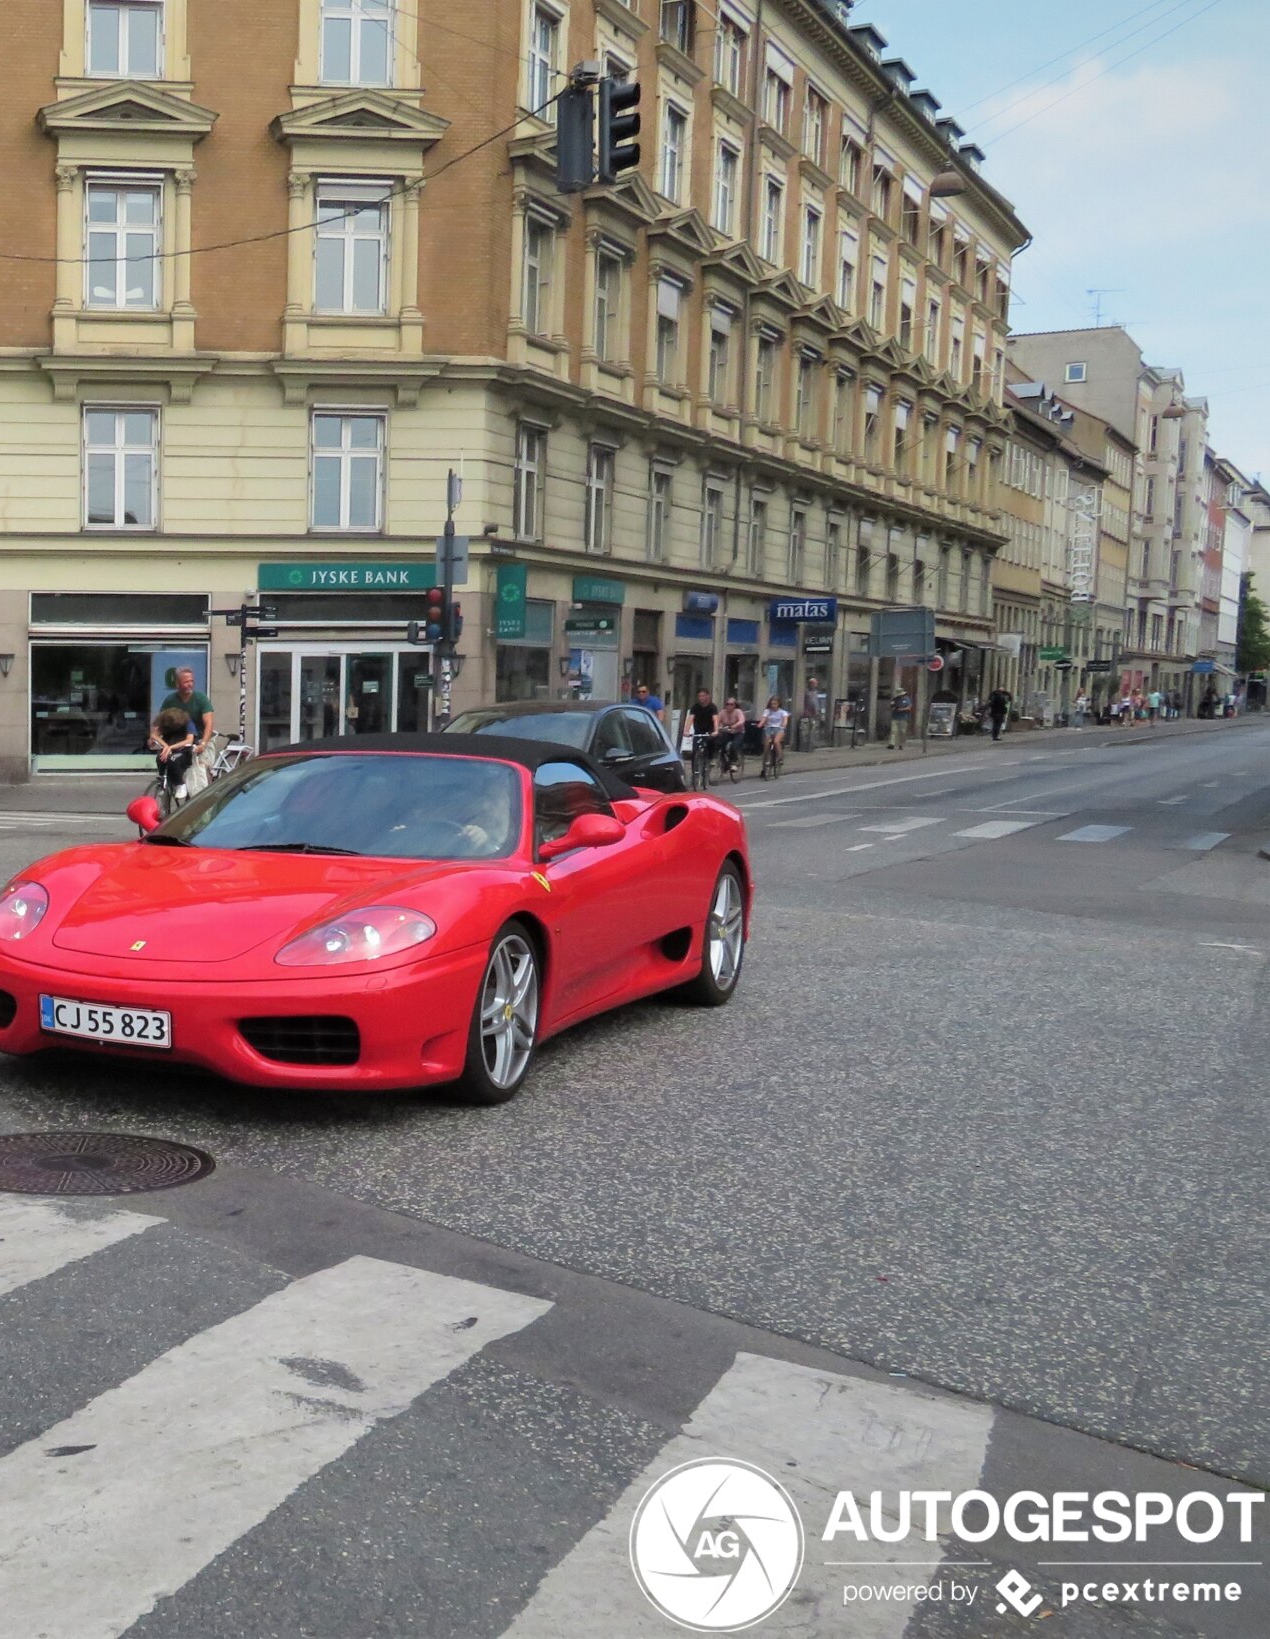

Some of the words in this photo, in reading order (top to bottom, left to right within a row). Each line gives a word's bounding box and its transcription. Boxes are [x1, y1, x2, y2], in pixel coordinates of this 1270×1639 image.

[311, 570, 359, 584] JYSKE
[365, 570, 410, 584] BANK
[776, 601, 829, 618] matas
[55, 1004, 81, 1029] CJ
[88, 1009, 114, 1035] 55
[121, 1013, 166, 1041] 823
